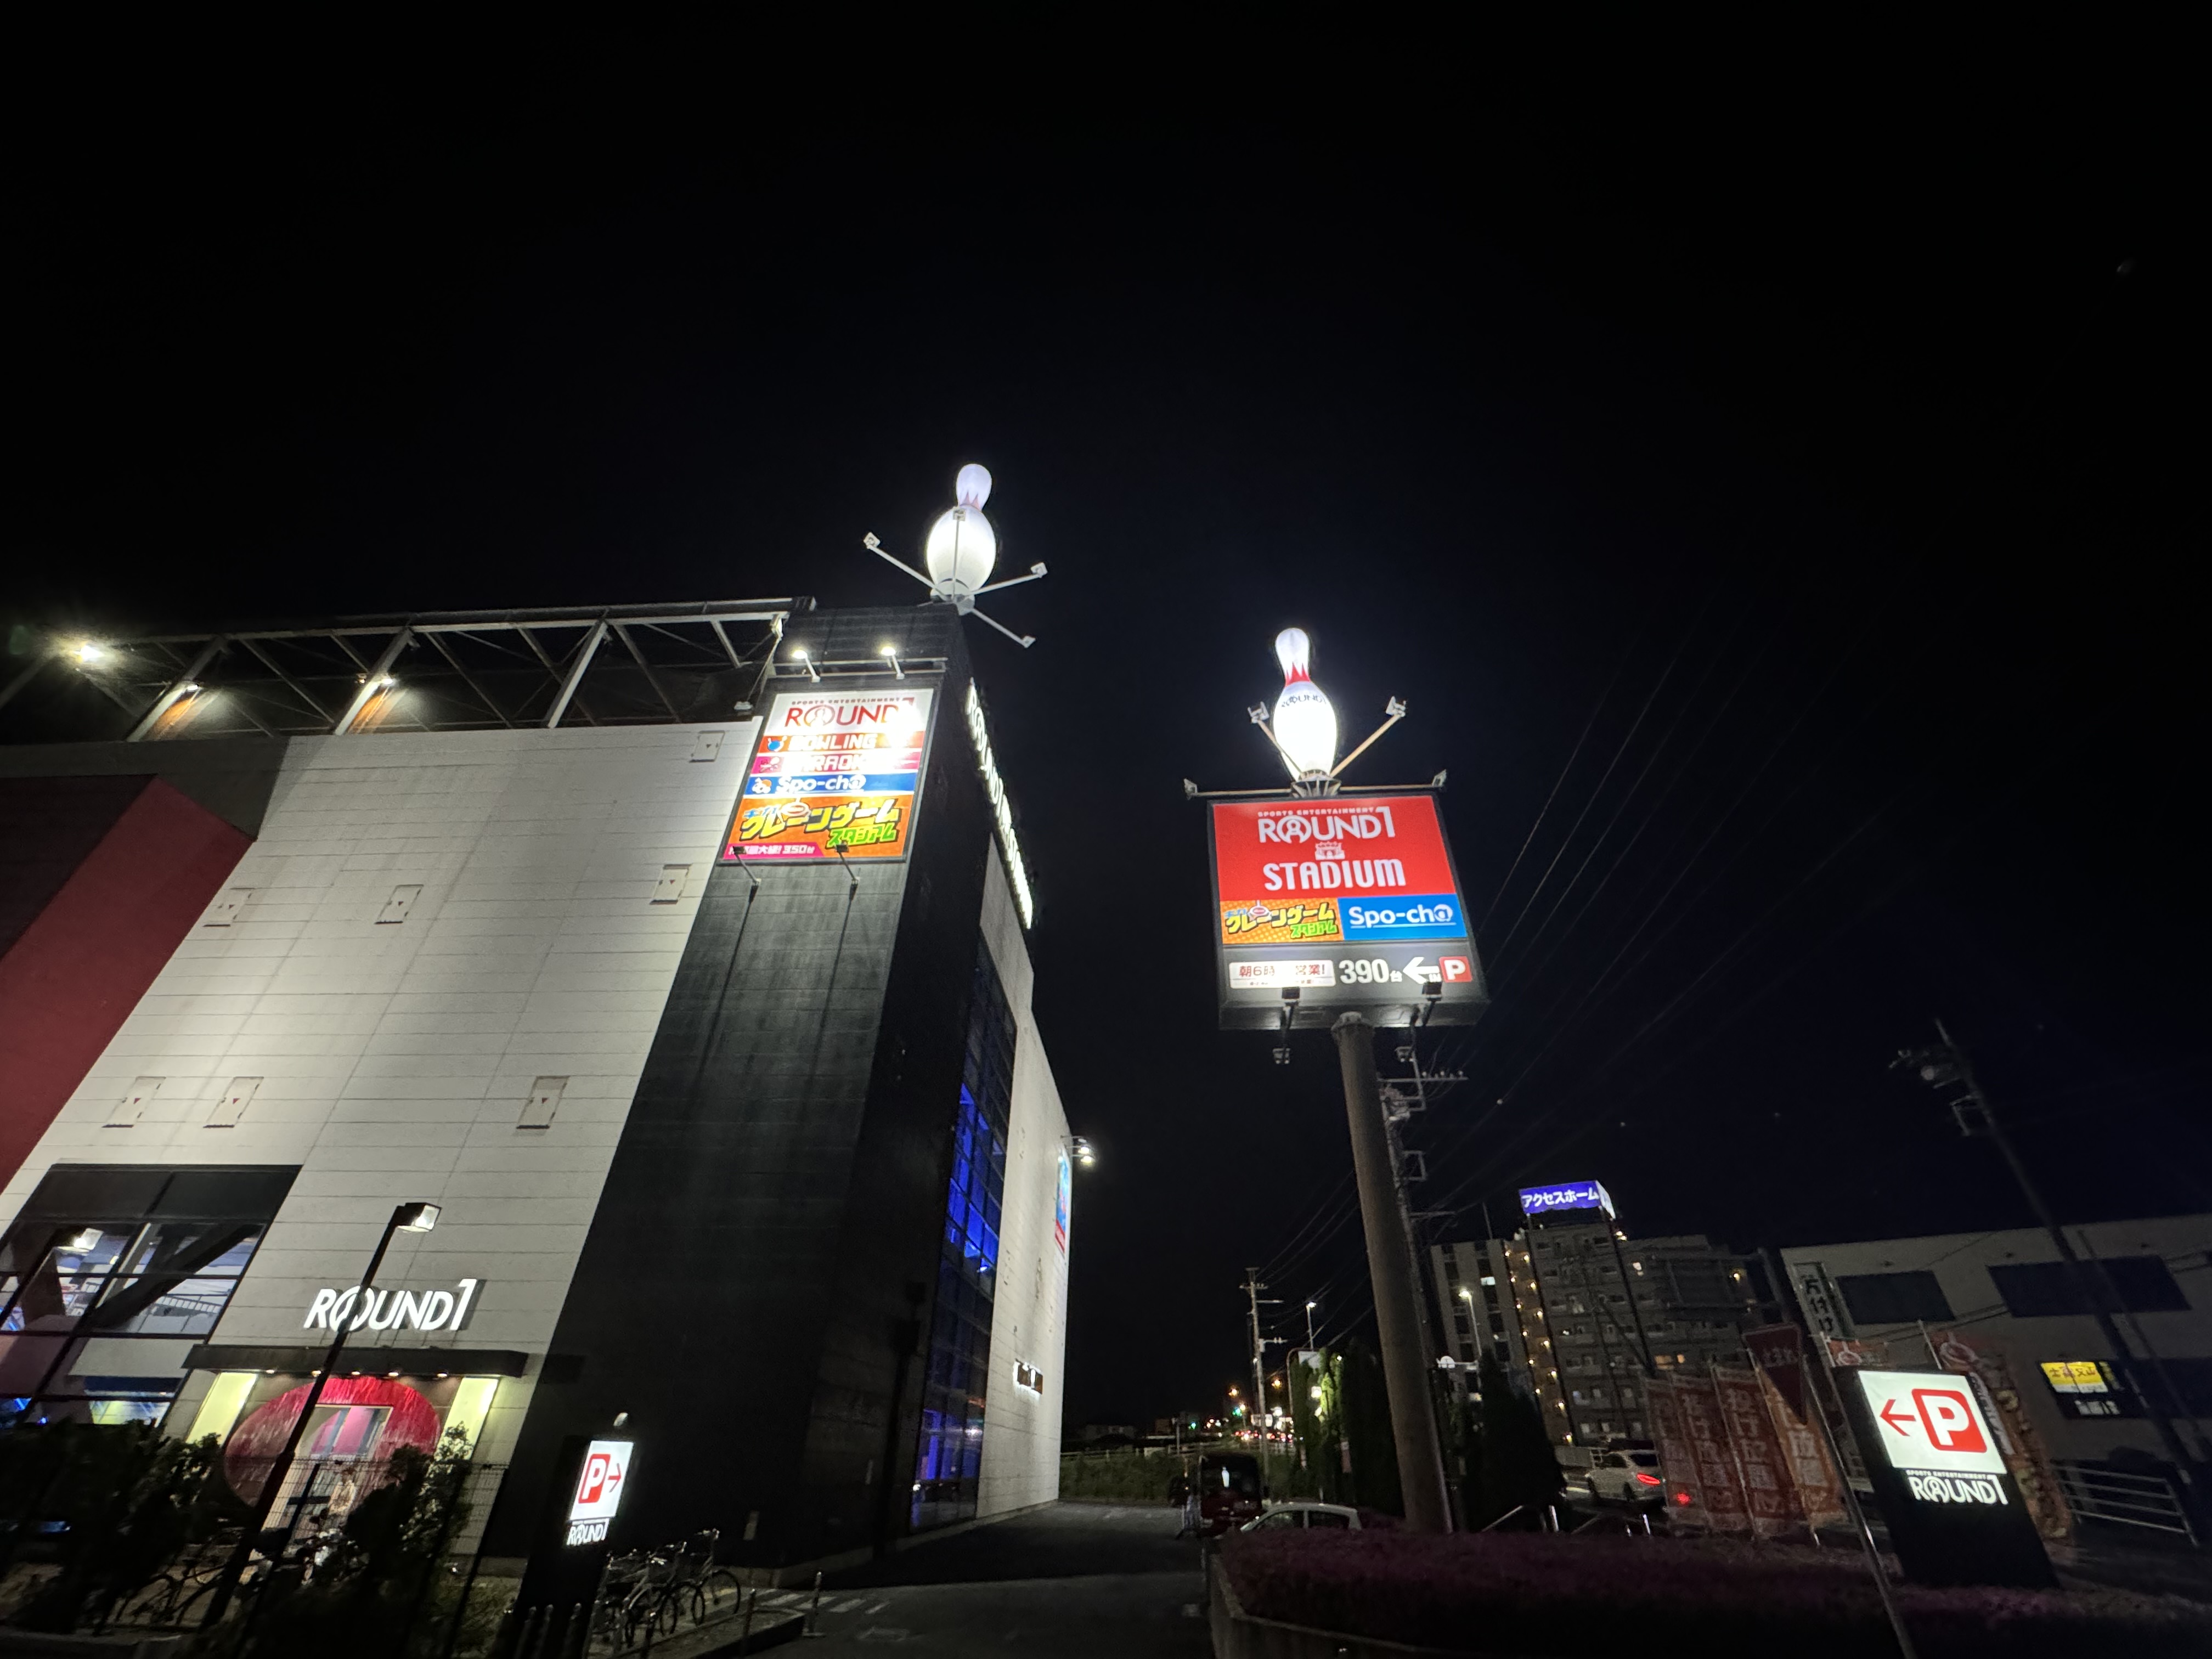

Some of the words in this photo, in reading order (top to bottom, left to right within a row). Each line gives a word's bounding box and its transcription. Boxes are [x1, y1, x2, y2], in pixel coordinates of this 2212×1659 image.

[741, 799, 899, 839] クレーンゲーム
[1258, 806, 1395, 843] ROUND1
[1297, 807, 1374, 815] ENTERTAINMENT
[1263, 859, 1406, 891] STADIUM
[1226, 902, 1334, 934] クレーンゲーム
[1290, 920, 1338, 939] スタジアム
[1444, 960, 1466, 980] P
[1521, 1187, 1600, 1208] アクセスホーム
[303, 1278, 478, 1332] ROUND1
[1921, 1395, 1969, 1446] P
[582, 1459, 606, 1499] P
[1908, 1475, 2008, 1504] ROUND1
[567, 1519, 610, 1545] ROUND1
